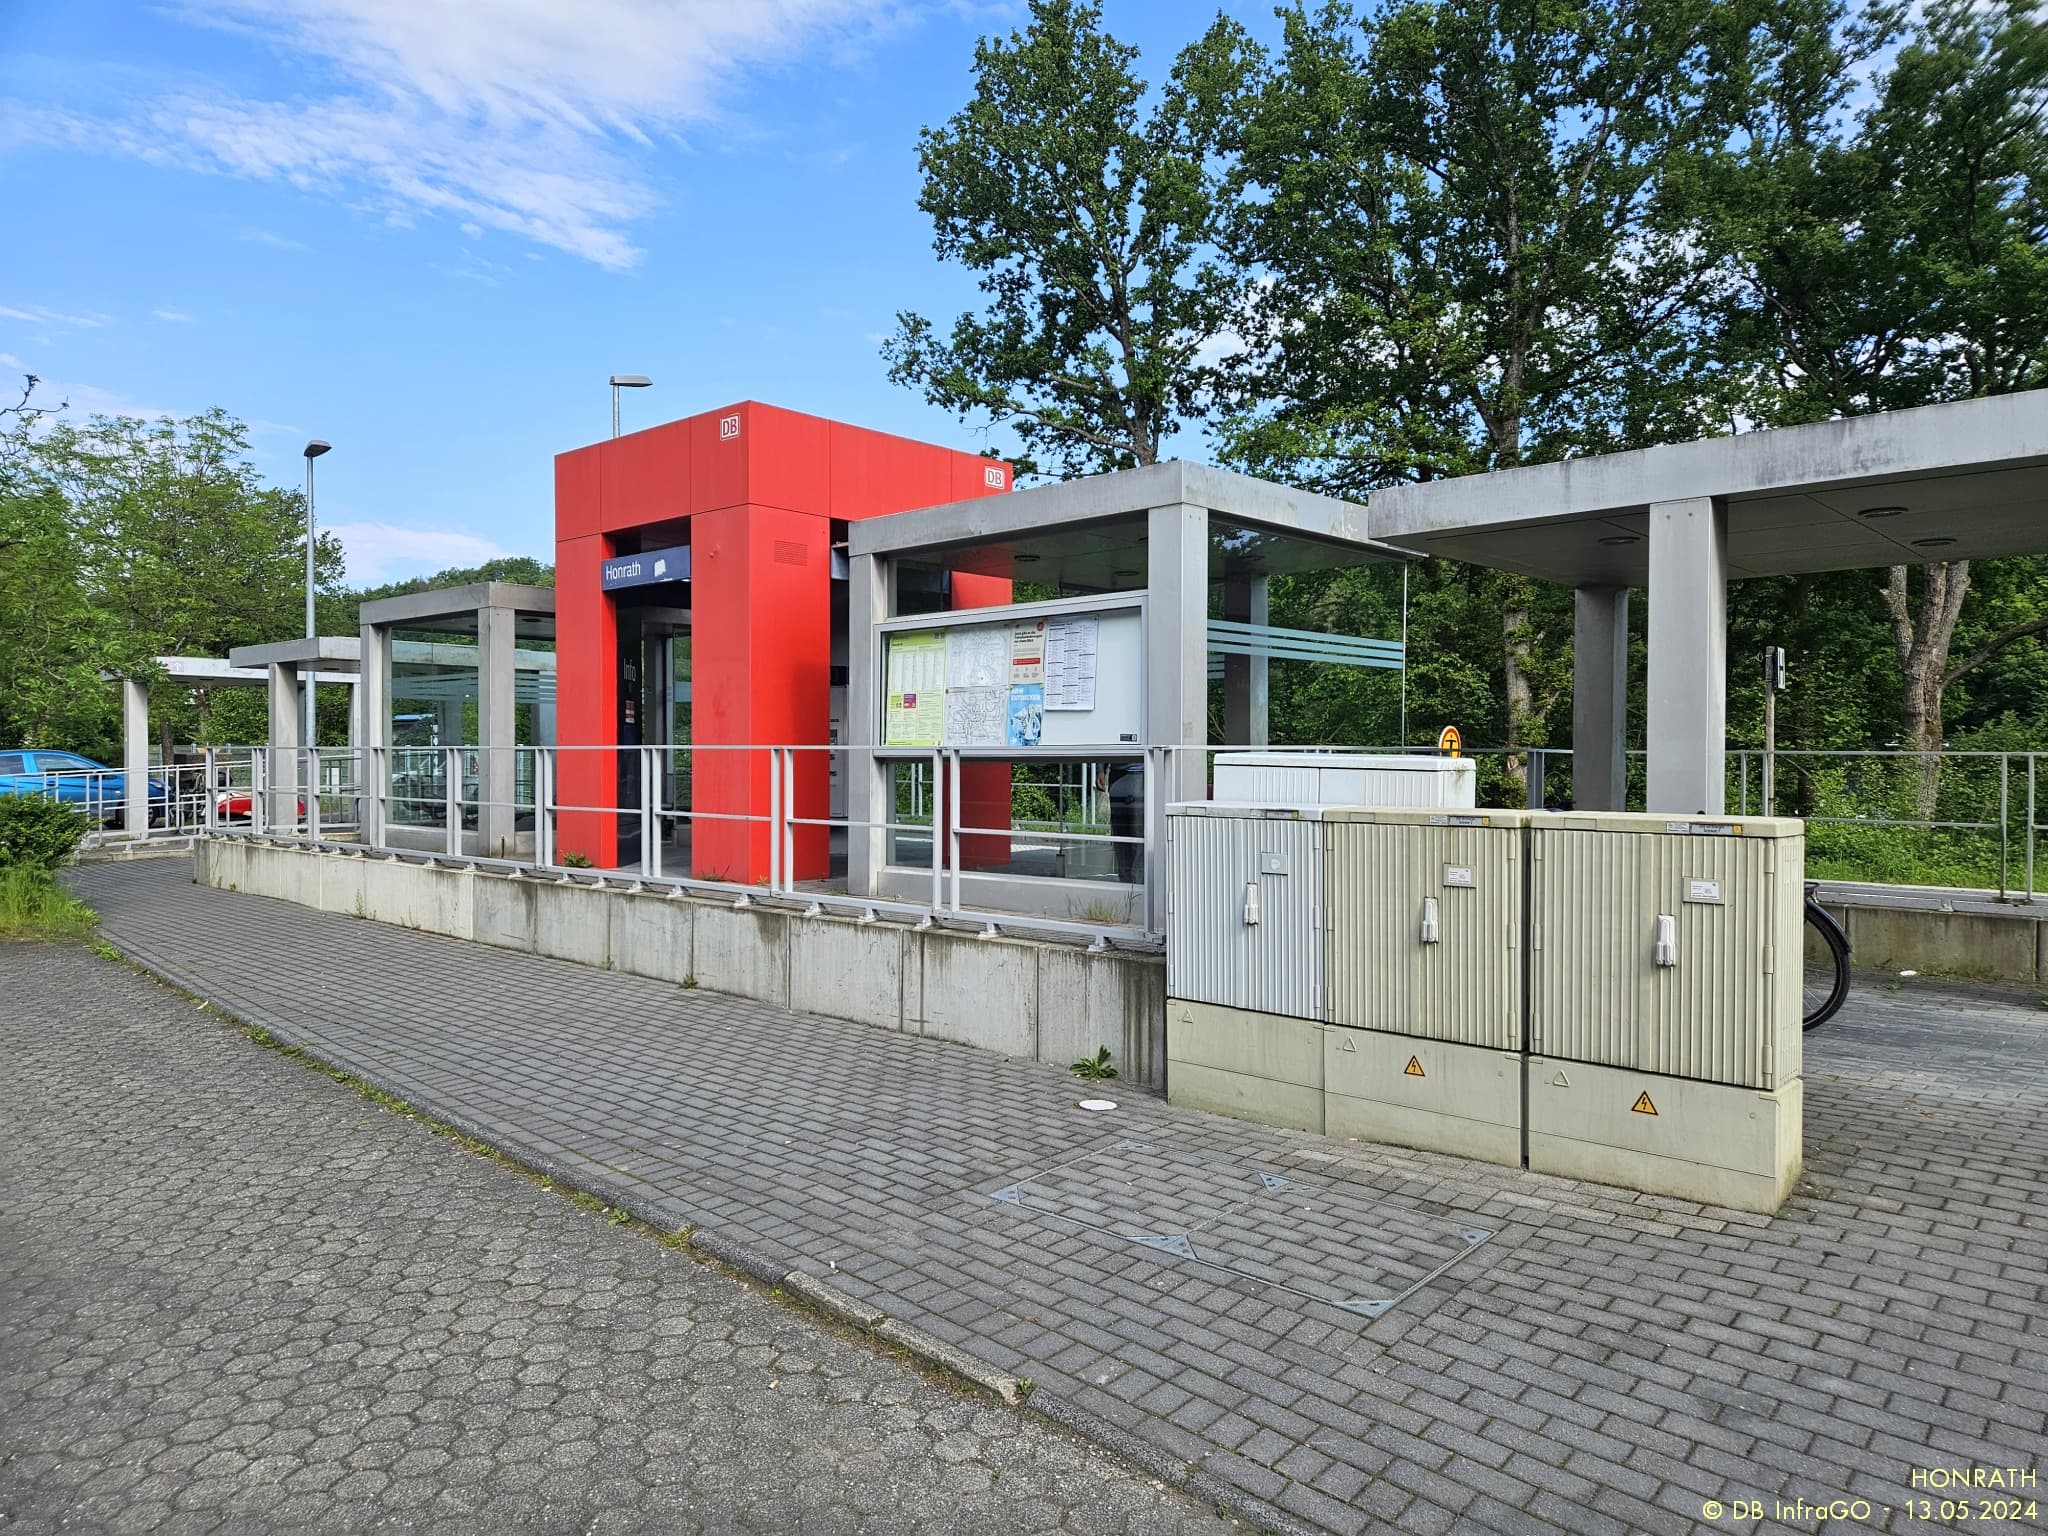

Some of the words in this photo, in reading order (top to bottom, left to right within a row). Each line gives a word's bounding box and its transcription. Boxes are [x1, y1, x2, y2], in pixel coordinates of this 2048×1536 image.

[722, 418, 738, 436] DB
[987, 469, 1002, 485] DB
[605, 561, 641, 581] Honrath
[623, 657, 637, 682] Info
